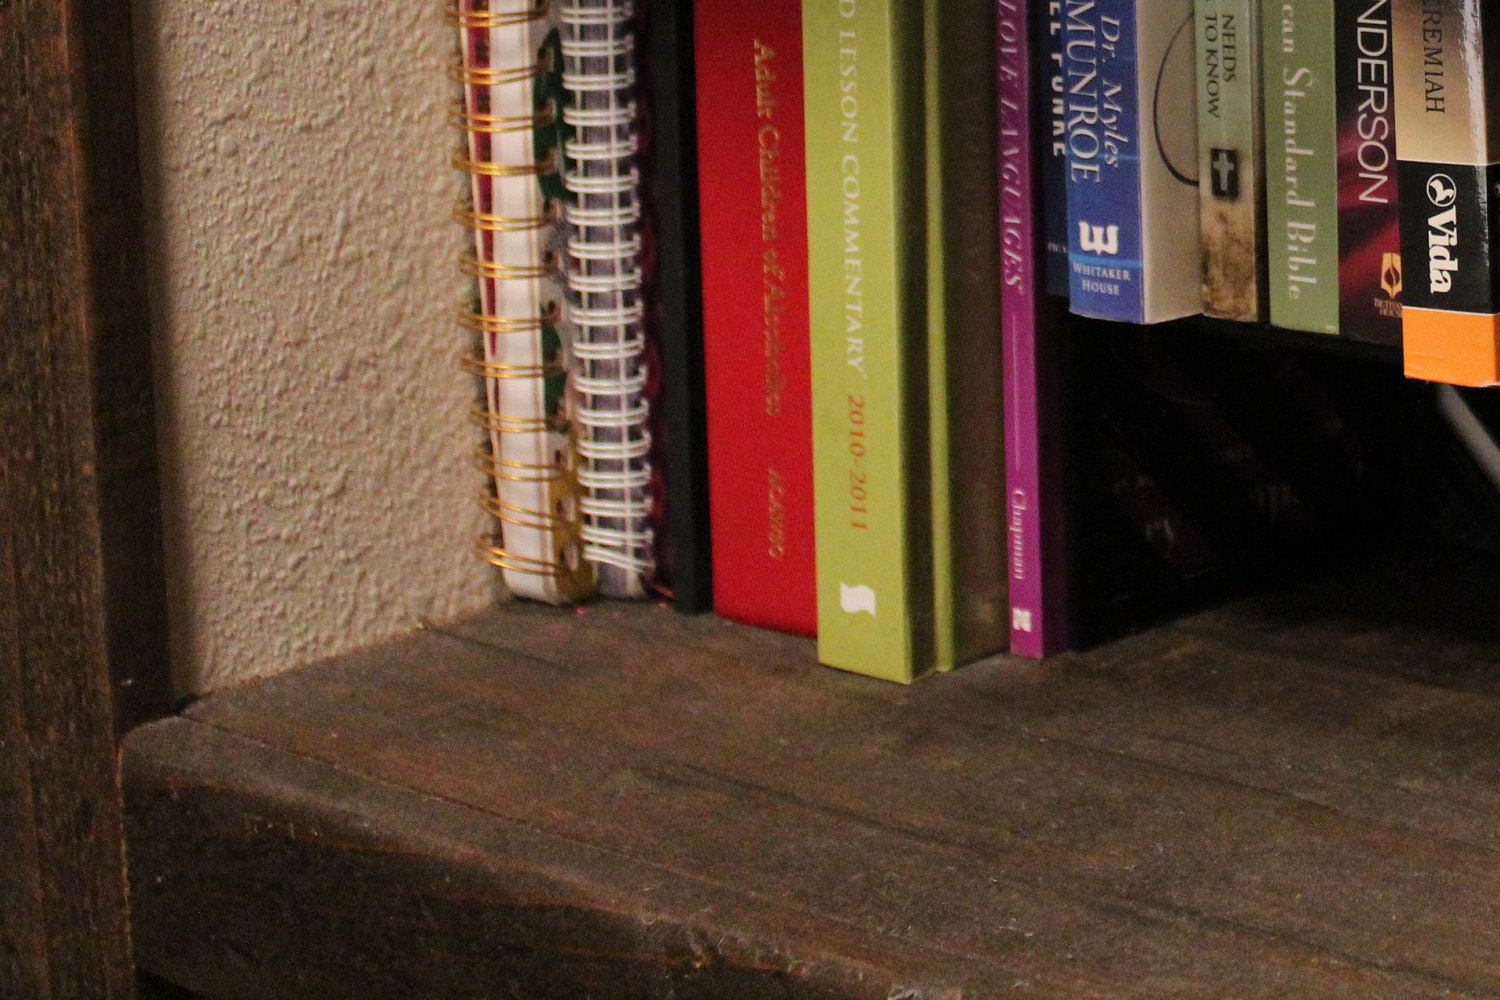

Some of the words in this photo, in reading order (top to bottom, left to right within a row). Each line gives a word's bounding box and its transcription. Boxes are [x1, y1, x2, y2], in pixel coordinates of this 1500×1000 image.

[1100, 15, 1121, 62] Dr.
[1204, 13, 1219, 43] TO
[1220, 13, 1237, 83] NEEDS
[753, 38, 780, 119] Adult
[839, 31, 860, 144] LESSON
[1205, 48, 1222, 120] KNOW
[1102, 79, 1129, 169] Myles
[1283, 66, 1316, 208] Standard
[757, 125, 784, 242] Children
[1000, 95, 1025, 294] LANGUAGES
[763, 247, 785, 282] of
[839, 152, 865, 376] COMMENTARY
[1071, 262, 1131, 282] WHITAKER
[1081, 280, 1120, 297] HOUSE
[1287, 220, 1317, 301] Bible
[1427, 205, 1459, 295] Vida
[847, 394, 868, 532] 2010-2011
[1011, 488, 1025, 581] Chapman
